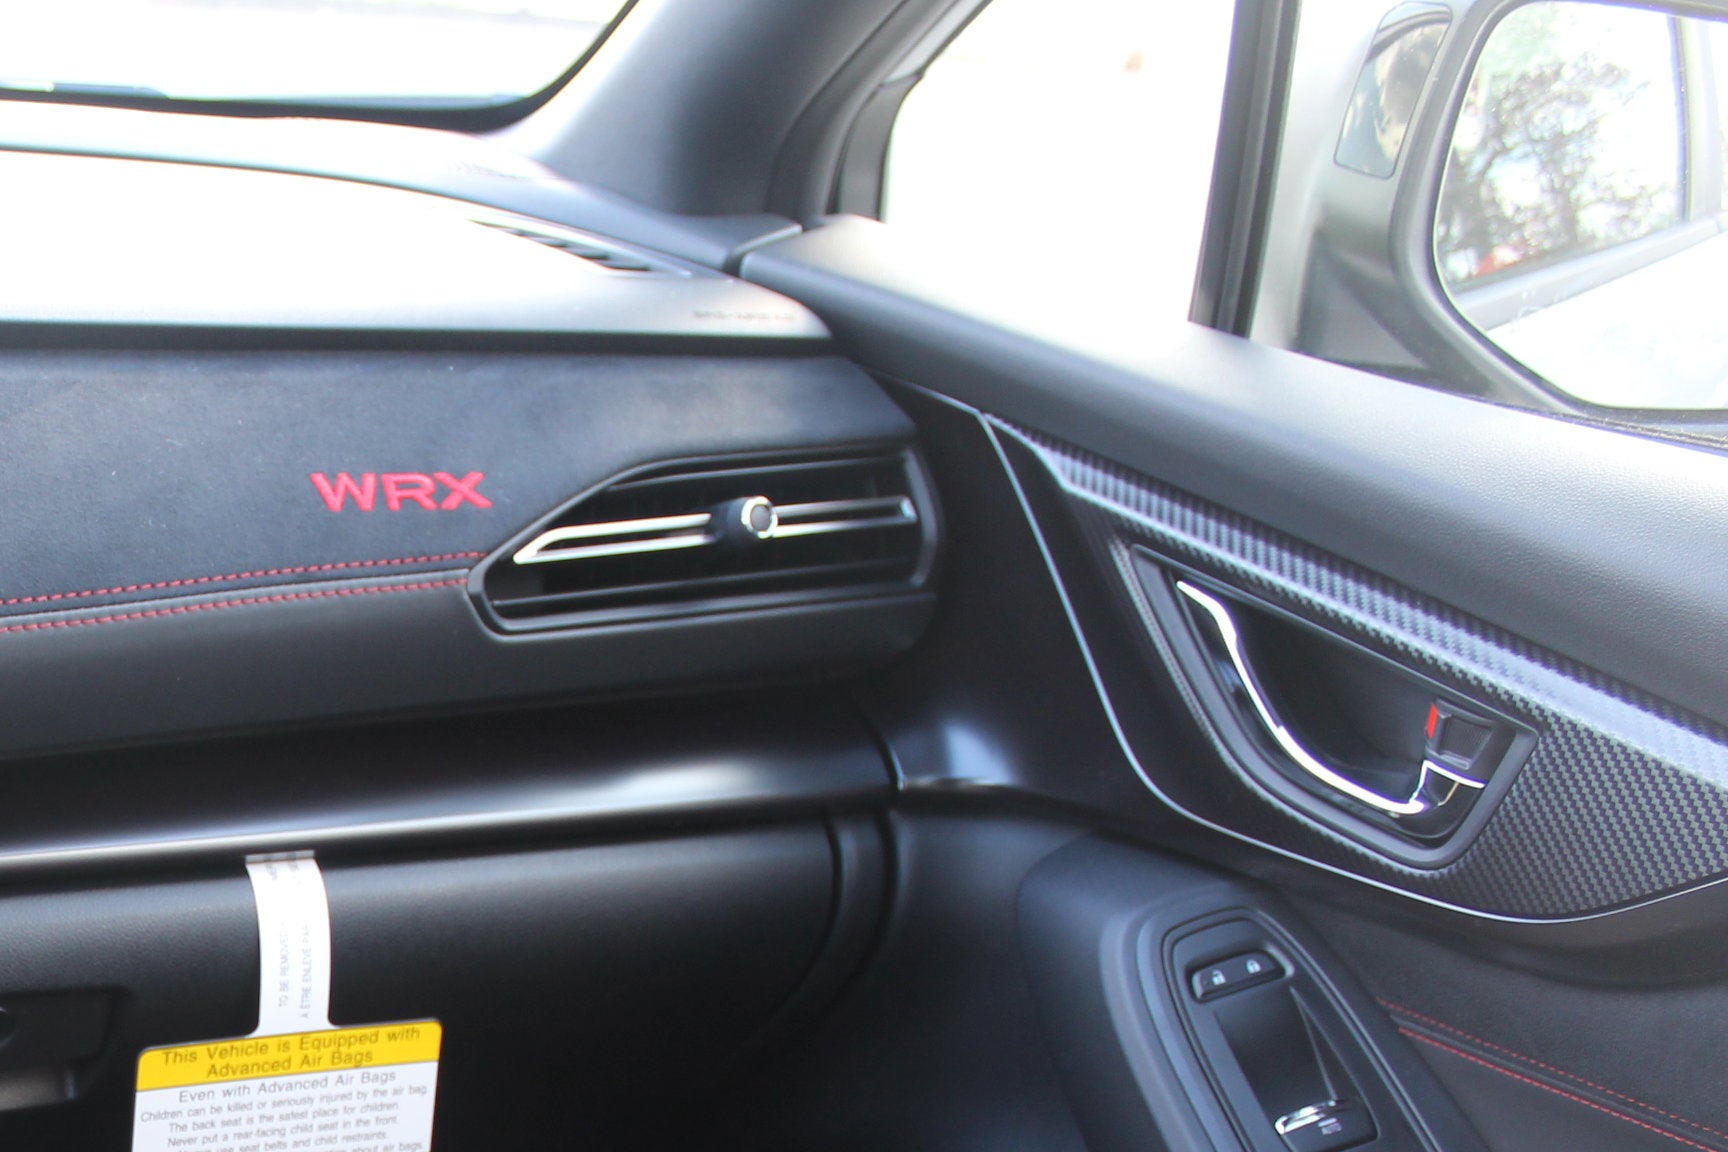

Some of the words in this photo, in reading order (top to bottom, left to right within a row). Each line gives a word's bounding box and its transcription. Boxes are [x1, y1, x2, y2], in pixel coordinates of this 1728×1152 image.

[309, 471, 493, 512] WRX
[161, 1048, 197, 1065] This
[205, 1041, 269, 1060] Vehicle
[277, 1039, 290, 1053] is
[299, 1029, 379, 1053] Equipped
[386, 1025, 420, 1042] with
[206, 1056, 291, 1078] Advanced
[299, 1053, 322, 1069] Air
[330, 1048, 373, 1068] Bags
[178, 1087, 215, 1102] Even
[221, 1083, 251, 1098] with
[257, 1075, 328, 1094] Advanced
[334, 1073, 354, 1086] Air
[360, 1068, 396, 1086] Bags
